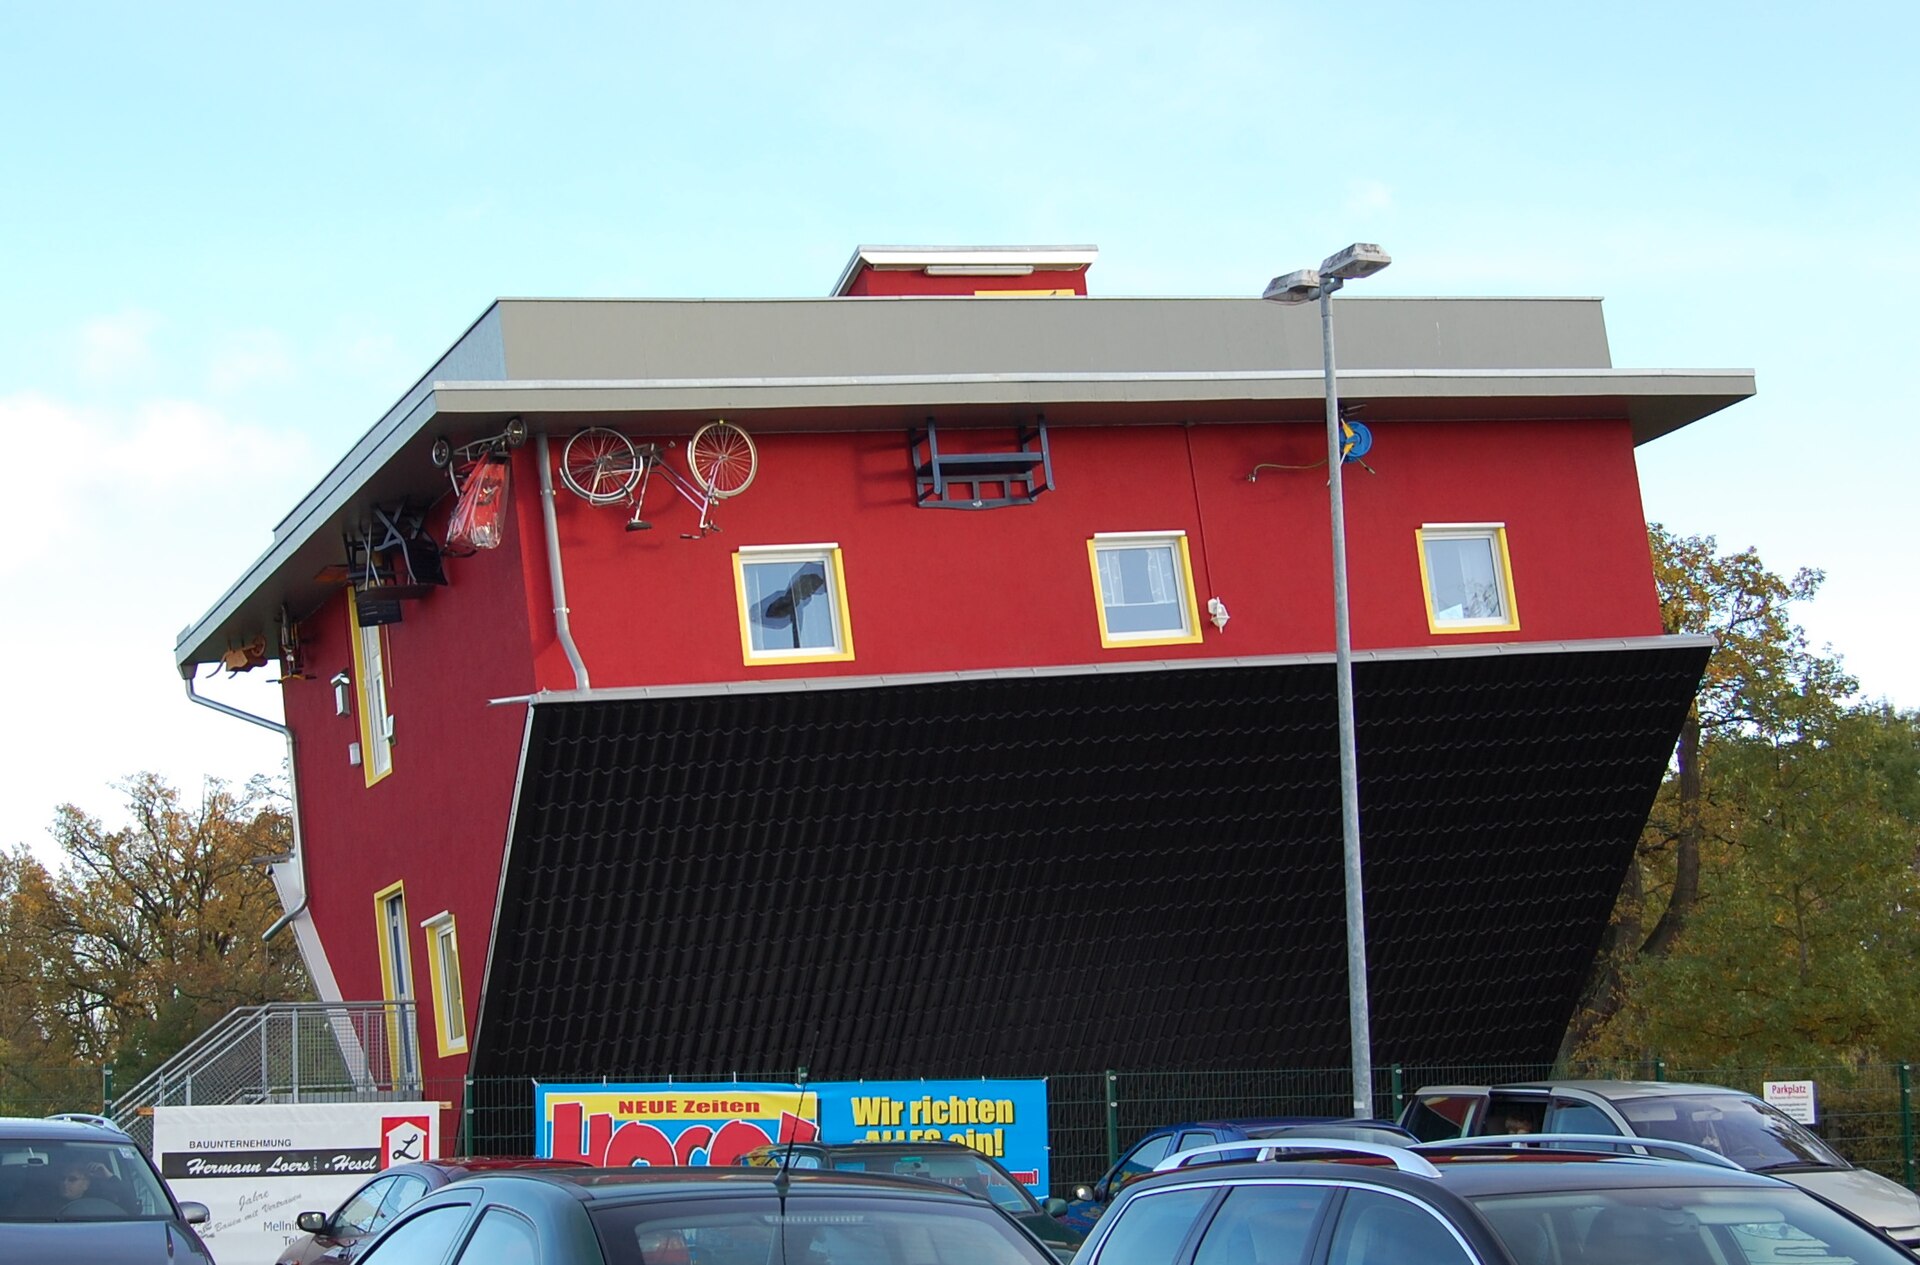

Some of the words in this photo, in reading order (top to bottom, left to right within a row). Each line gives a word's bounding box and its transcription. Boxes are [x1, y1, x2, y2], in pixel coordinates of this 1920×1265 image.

[1771, 1084, 1806, 1095] Parkplatz
[618, 1100, 677, 1114] NEUE
[683, 1099, 760, 1113] Zeiten
[851, 1096, 904, 1126] Wir
[909, 1095, 1015, 1124] richten
[189, 1139, 292, 1149] BAUUNTERNEHMUNG
[186, 1158, 261, 1175] Hermann
[266, 1157, 310, 1173] Loers
[331, 1154, 376, 1171] Hesel
[239, 1190, 269, 1212] Jahre
[244, 1209, 259, 1220] mit
[261, 1193, 302, 1213] Vertrauen
